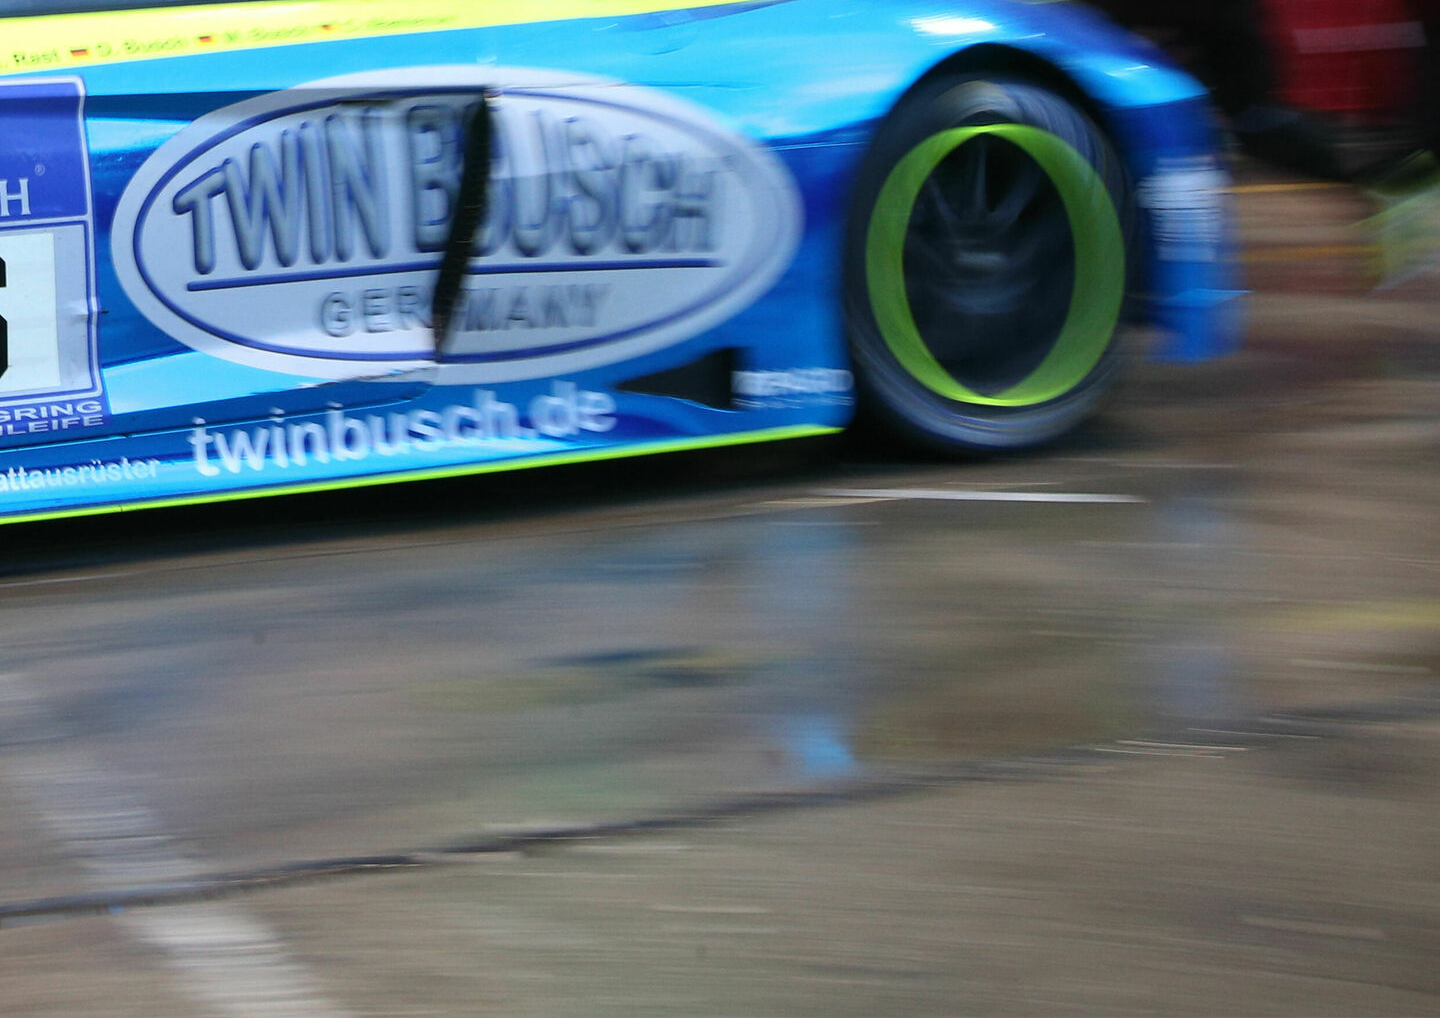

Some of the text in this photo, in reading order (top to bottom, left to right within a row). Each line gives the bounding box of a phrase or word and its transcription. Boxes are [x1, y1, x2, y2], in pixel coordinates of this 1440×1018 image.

[13, 49, 59, 66] Rast
[173, 103, 718, 276] TWIN BUSCH
[321, 285, 612, 338] GERMANY
[187, 380, 618, 477] twinbusch.de
